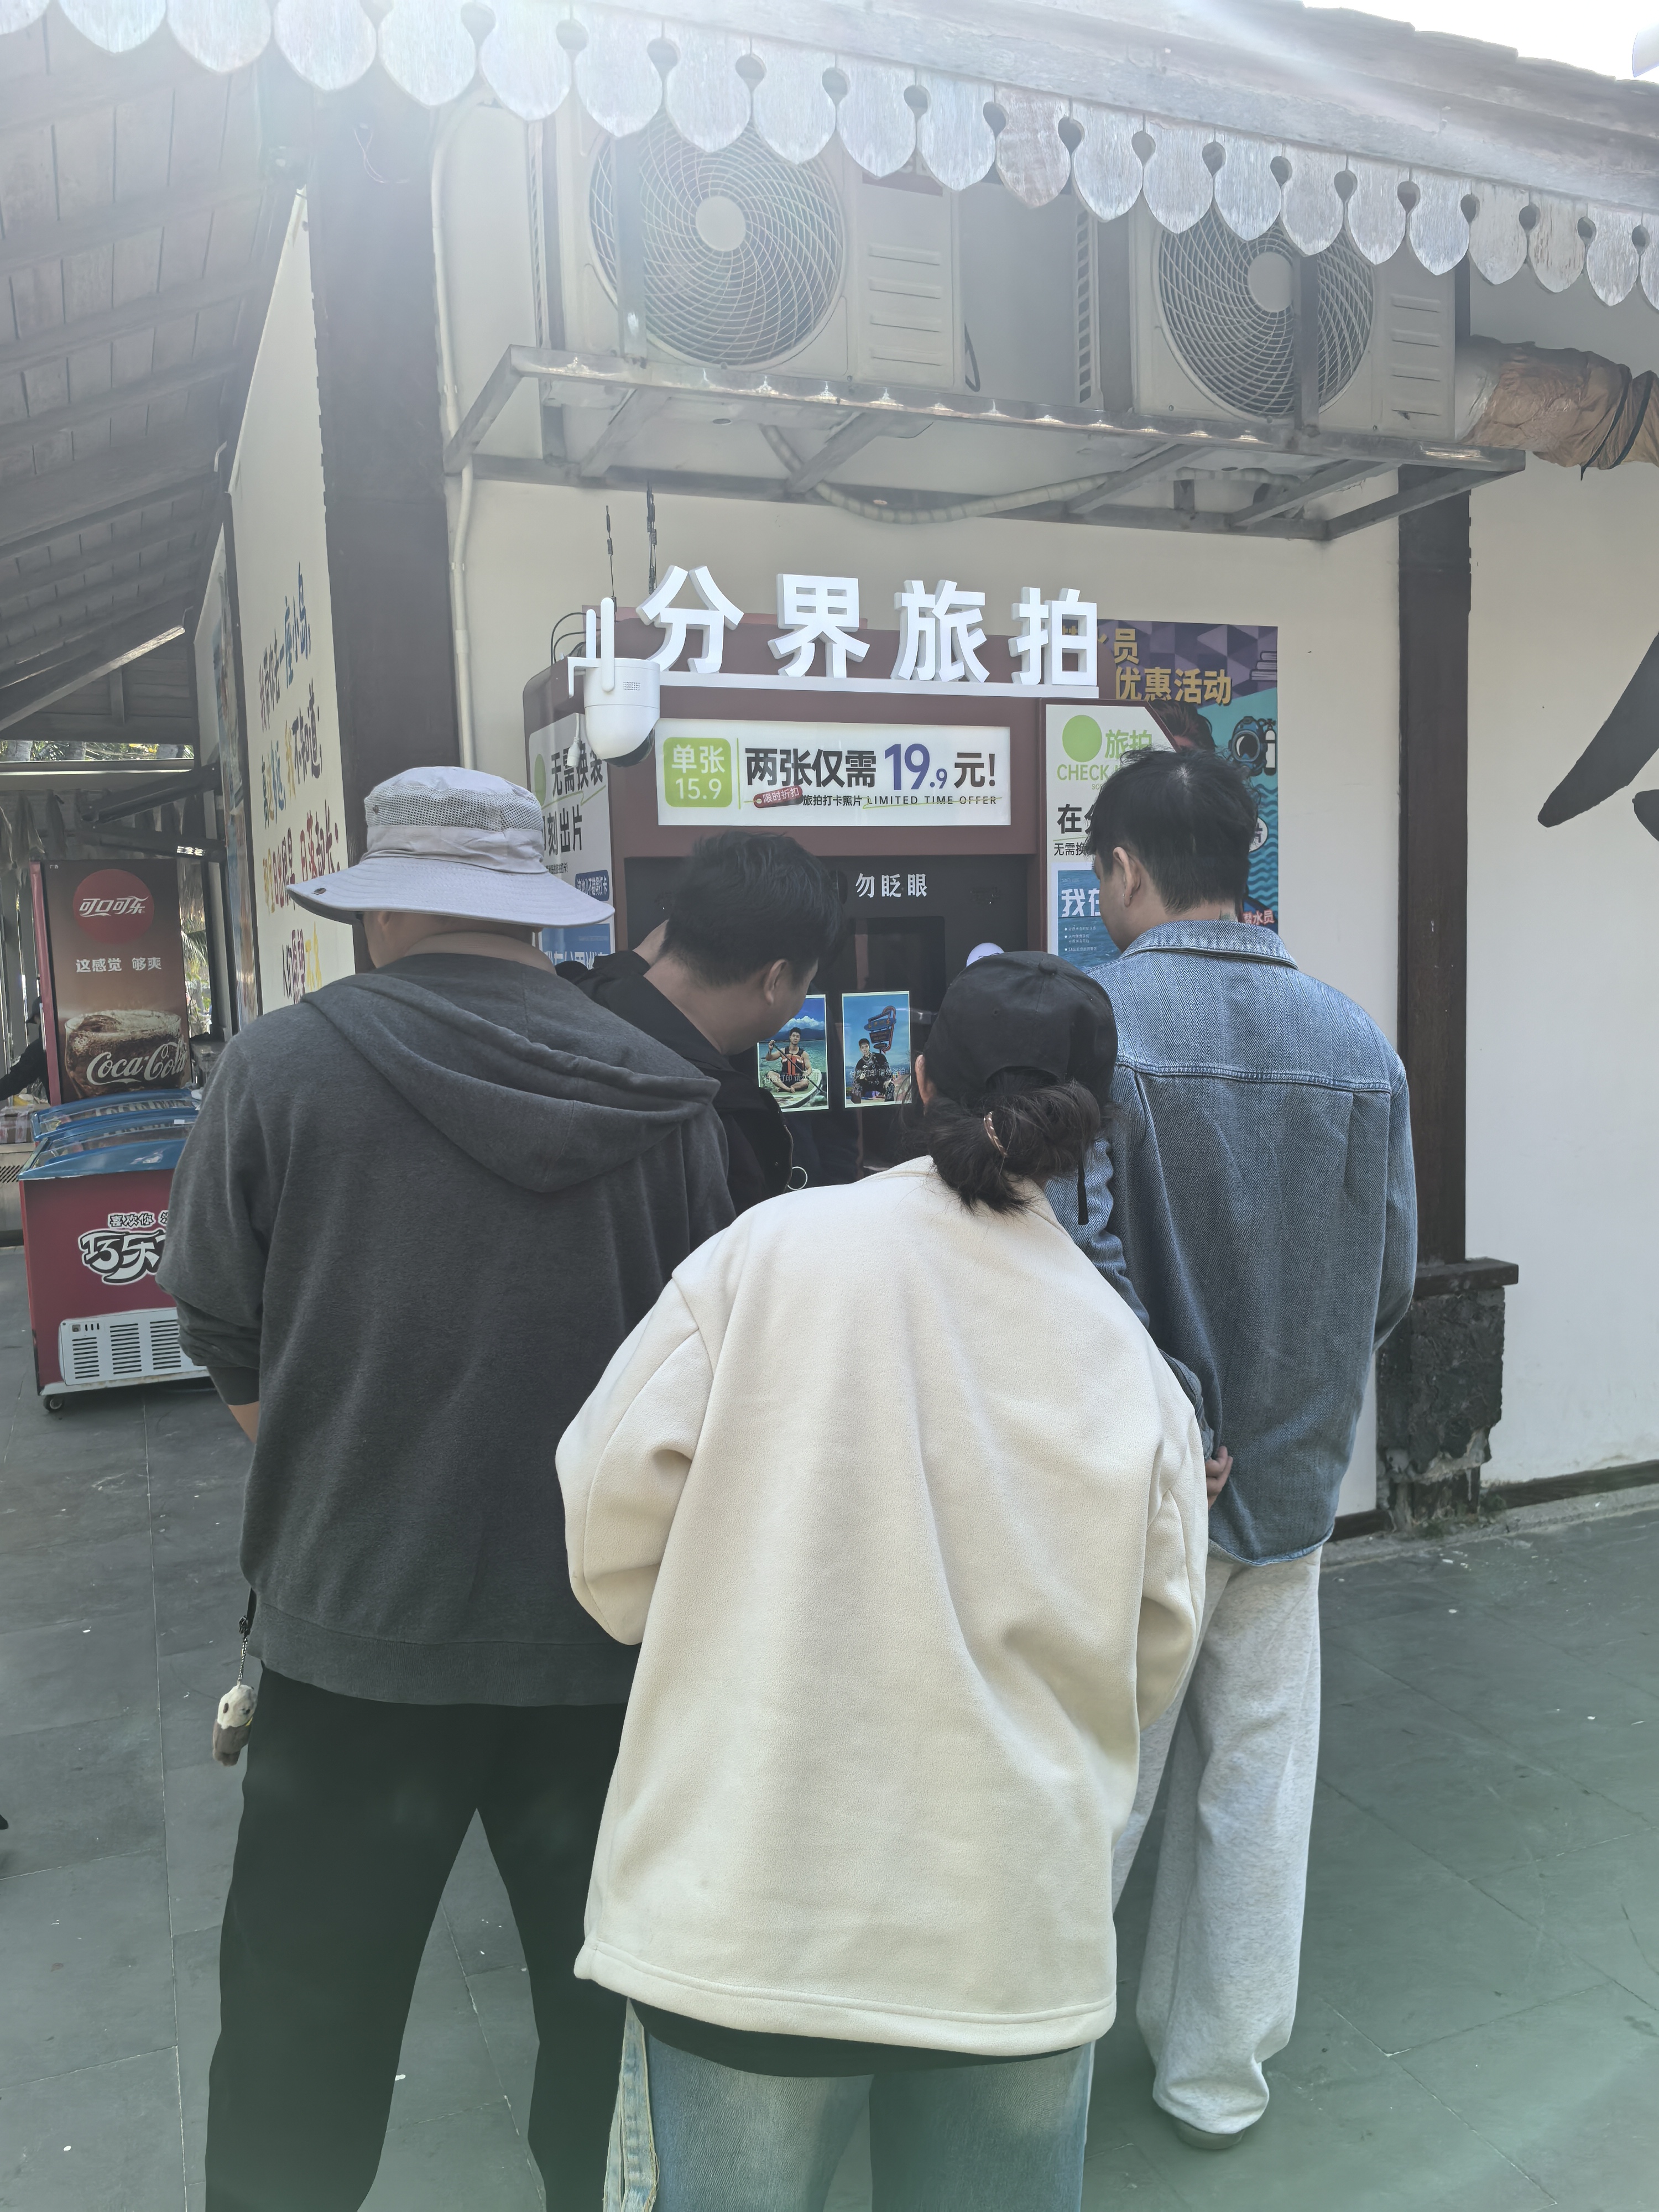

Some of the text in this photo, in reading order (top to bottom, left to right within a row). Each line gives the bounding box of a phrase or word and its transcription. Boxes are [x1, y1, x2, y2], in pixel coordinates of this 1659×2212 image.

[637, 565, 1097, 686] 分界旅拍
[1115, 666, 1232, 706] 优惠活动
[671, 744, 726, 774] 单张
[1057, 764, 1109, 781] CHECK
[675, 778, 722, 800] 15.9
[763, 787, 800, 804] 限时折扣
[802, 795, 997, 806] 旅拍打卡照片 LIMITED TIME OFFER
[855, 873, 927, 899] 勿眨眼
[79, 895, 149, 917] 可口可乐
[76, 957, 162, 973] 这感觉 够爽
[111, 1213, 154, 1227] 喜欢你
[81, 1229, 166, 1283] 巧乐
